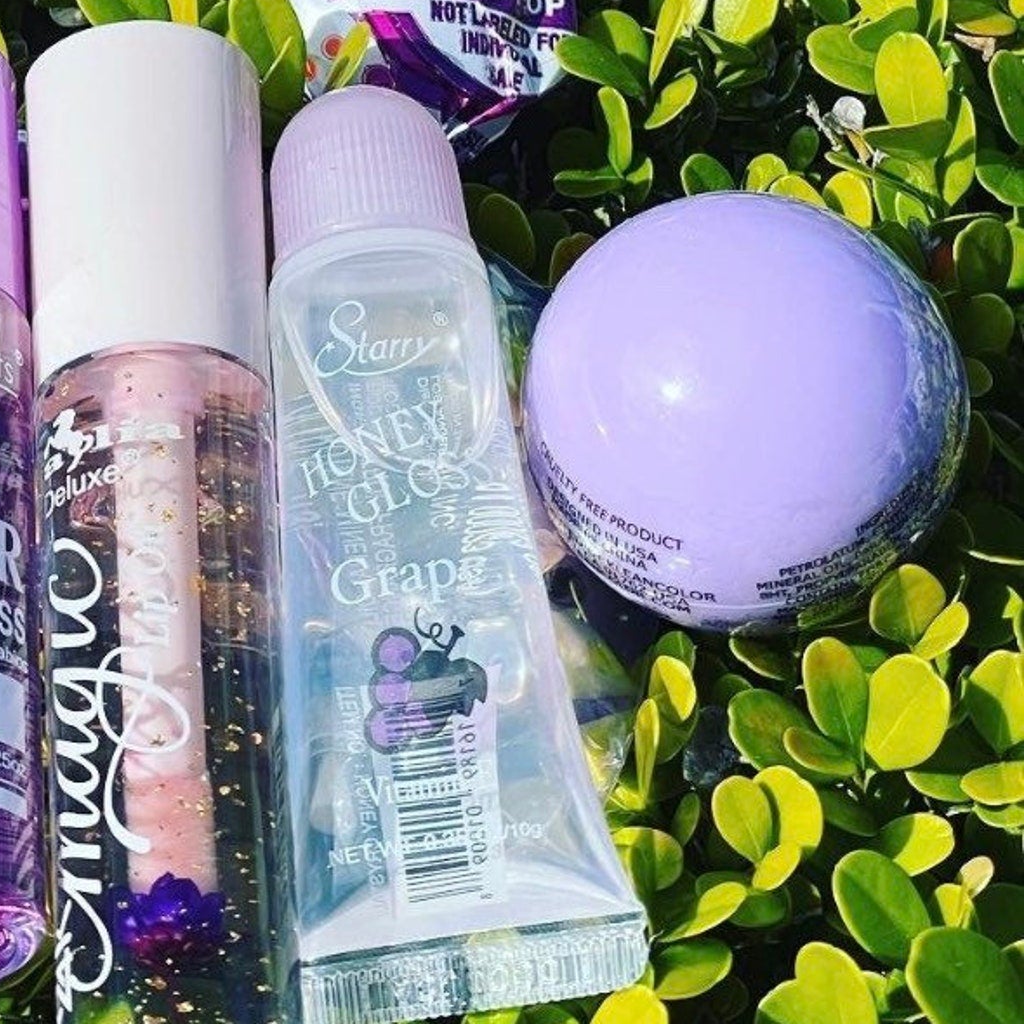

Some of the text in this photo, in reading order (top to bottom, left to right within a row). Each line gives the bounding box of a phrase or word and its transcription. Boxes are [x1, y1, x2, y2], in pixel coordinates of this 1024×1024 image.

[430, 0, 468, 24] NOT
[537, 31, 567, 52] FO
[315, 300, 439, 377] Starry
[297, 398, 443, 499] HONEY
[579, 493, 609, 520] FREE
[610, 514, 684, 551] PRODUCT
[756, 571, 820, 591] MINERAL
